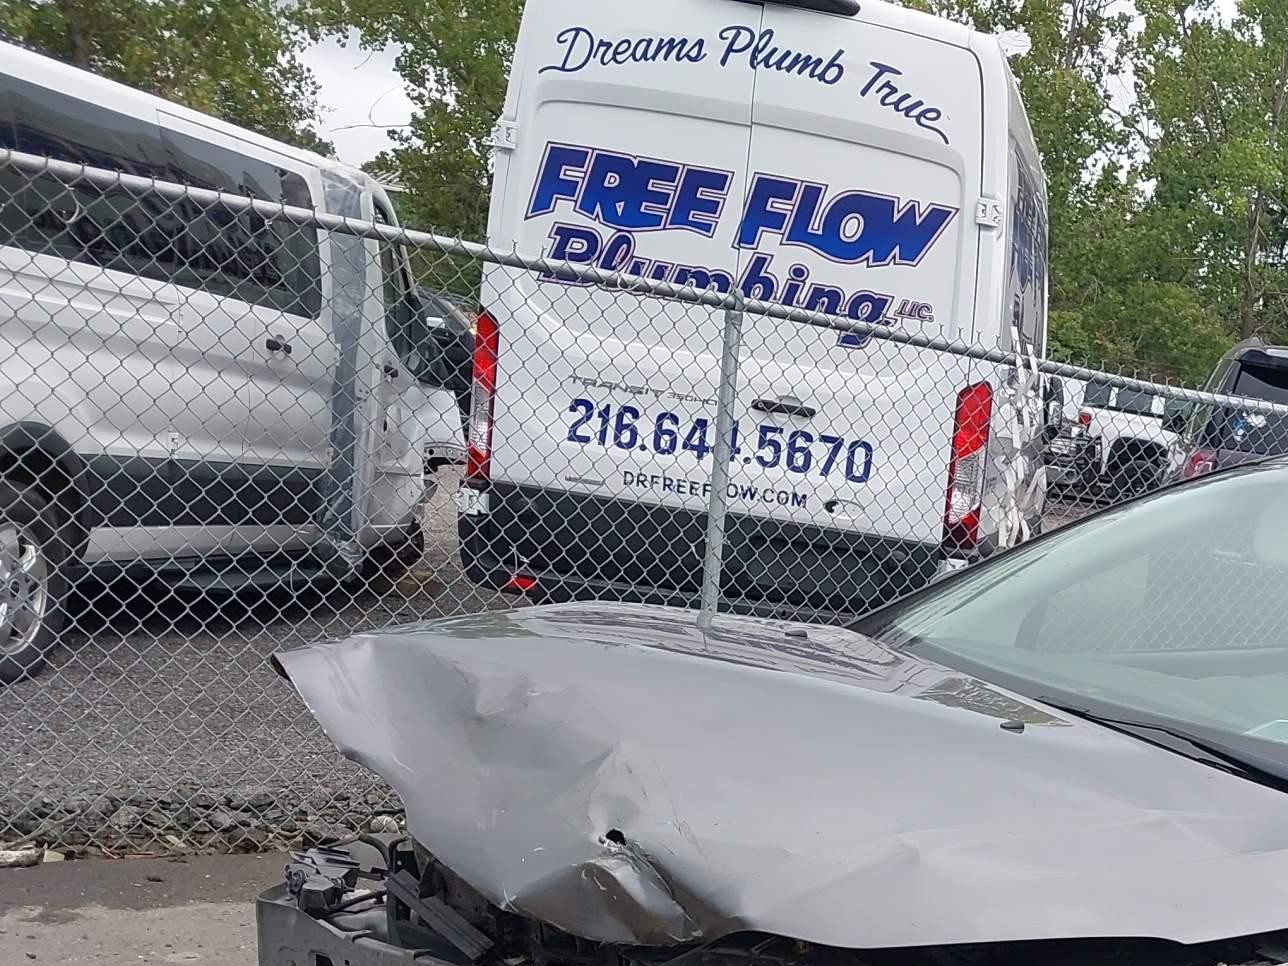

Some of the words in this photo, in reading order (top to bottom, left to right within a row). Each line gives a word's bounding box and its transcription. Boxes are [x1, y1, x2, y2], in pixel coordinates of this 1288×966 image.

[538, 27, 708, 75] Dreams
[718, 25, 846, 86] Plumb
[857, 61, 950, 145] True
[524, 141, 735, 239] FREE
[732, 172, 960, 268] FLOW
[537, 221, 897, 350] Plumbing
[568, 374, 665, 398] TRANSIT
[623, 470, 808, 509] DRFREEFOW.COM
